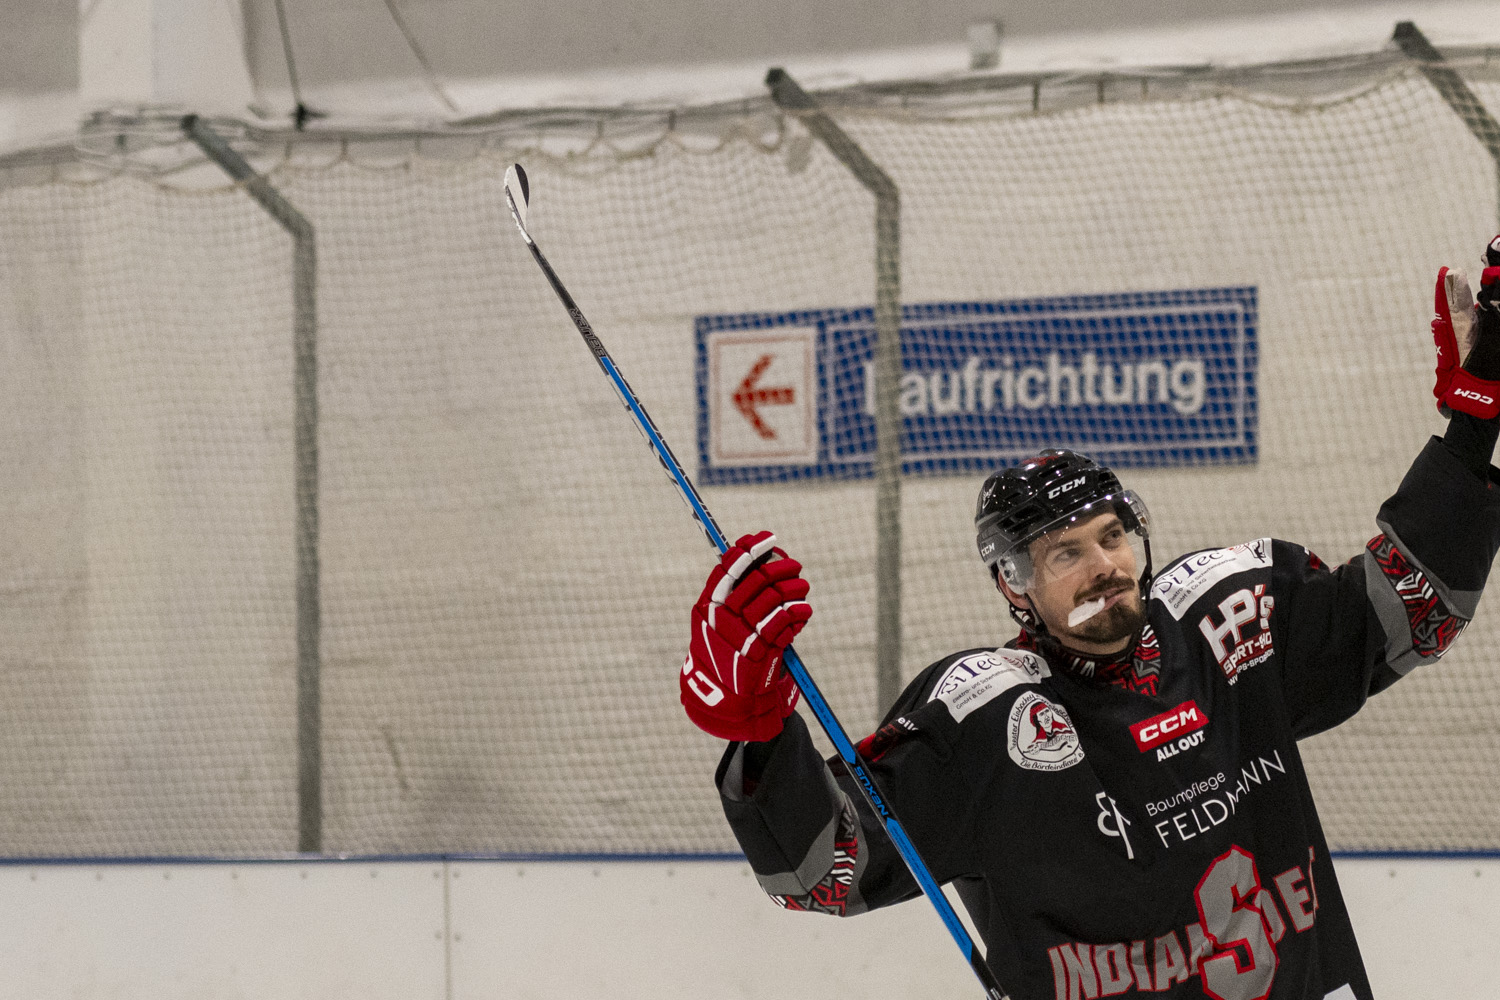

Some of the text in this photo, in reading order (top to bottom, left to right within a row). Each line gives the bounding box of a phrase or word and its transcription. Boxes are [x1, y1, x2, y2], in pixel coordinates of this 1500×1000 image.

[570, 308, 607, 357] BAUER
[1453, 388, 1494, 405] CCM
[1047, 476, 1086, 500] CCM
[981, 542, 995, 557] CCM
[765, 656, 779, 688] TACKS
[940, 658, 1003, 696] SiTec
[956, 697, 972, 710] GmbH
[1139, 707, 1198, 742] CCM
[1156, 730, 1206, 762] ALL OUT
[855, 766, 889, 816] NEXUS
[1145, 772, 1226, 817] Baumpflege
[1154, 750, 1286, 848] FELDMANN
